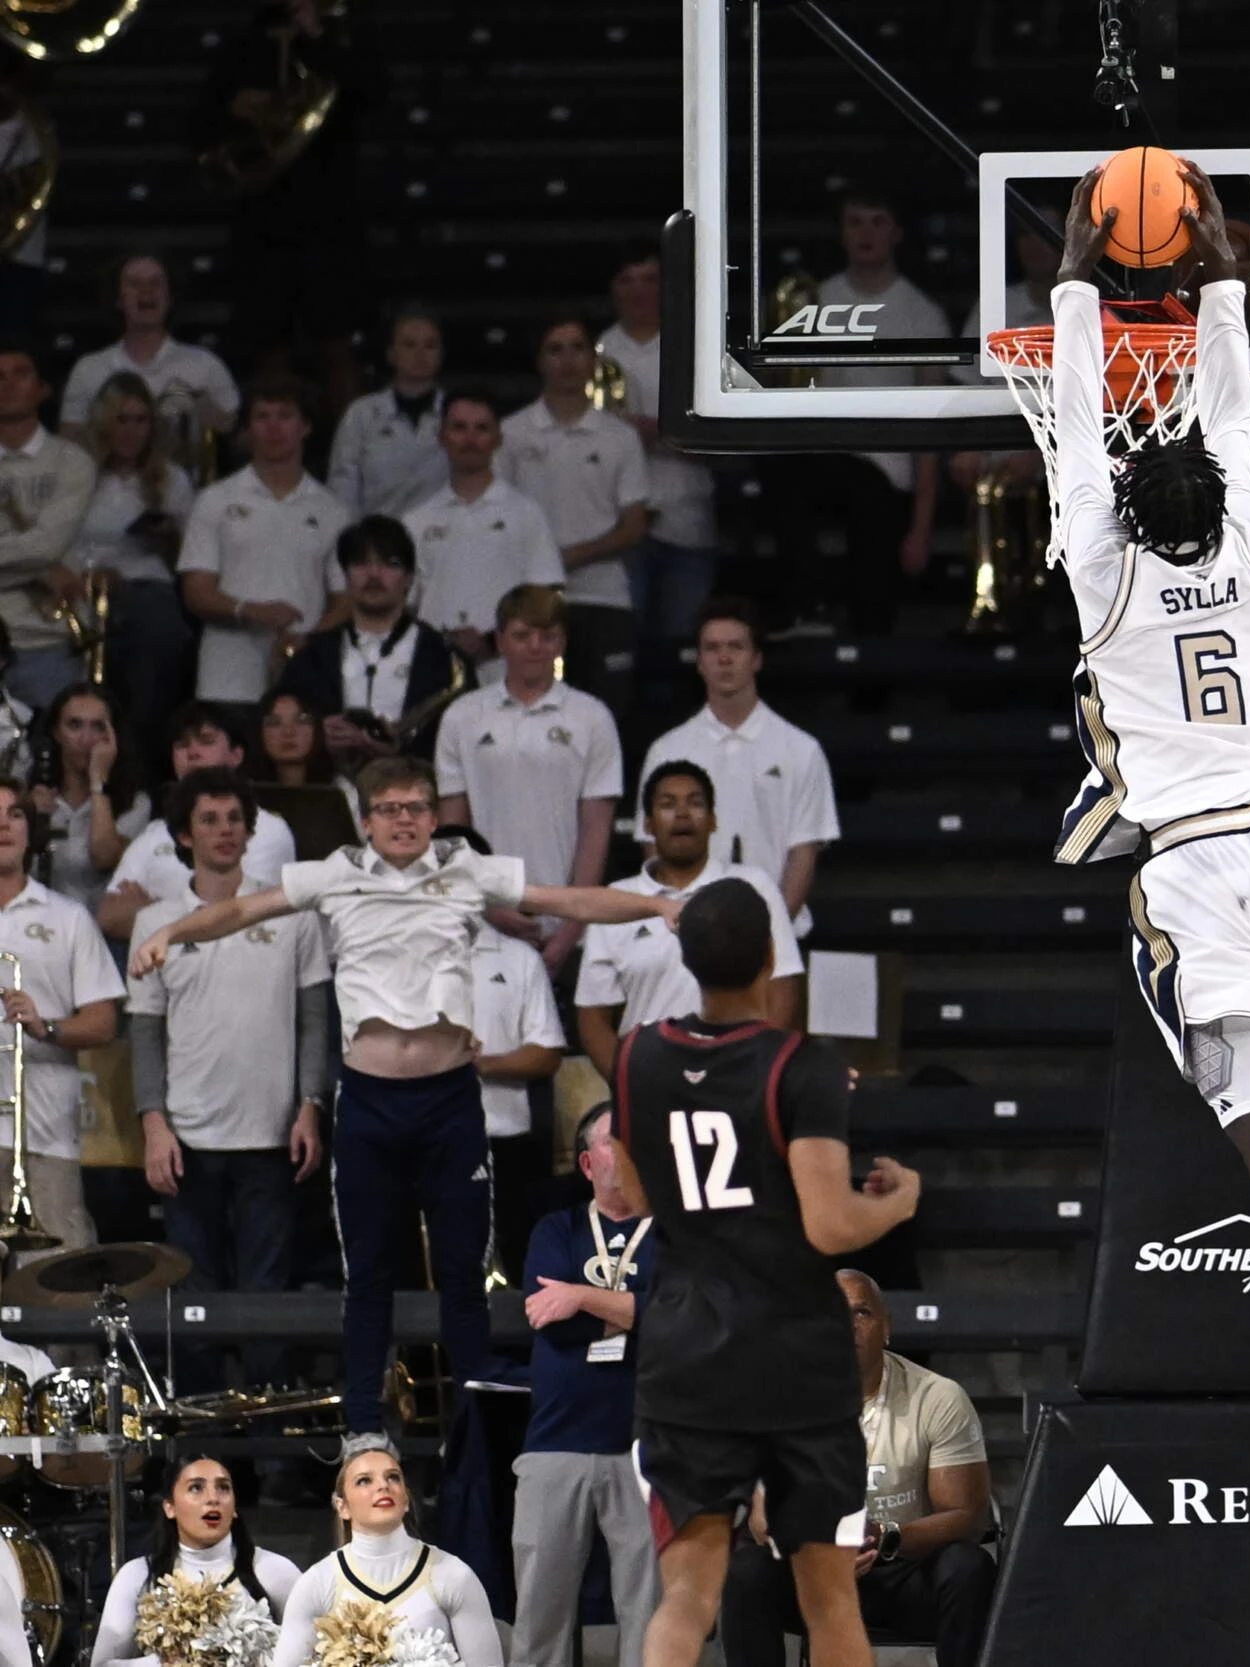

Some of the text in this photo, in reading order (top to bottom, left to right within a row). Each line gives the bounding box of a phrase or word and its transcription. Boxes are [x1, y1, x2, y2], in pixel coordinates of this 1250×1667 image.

[772, 304, 886, 334] ACC
[1160, 577, 1238, 614] SYLLA
[1174, 629, 1246, 725] 6
[669, 1110, 754, 1211] 12
